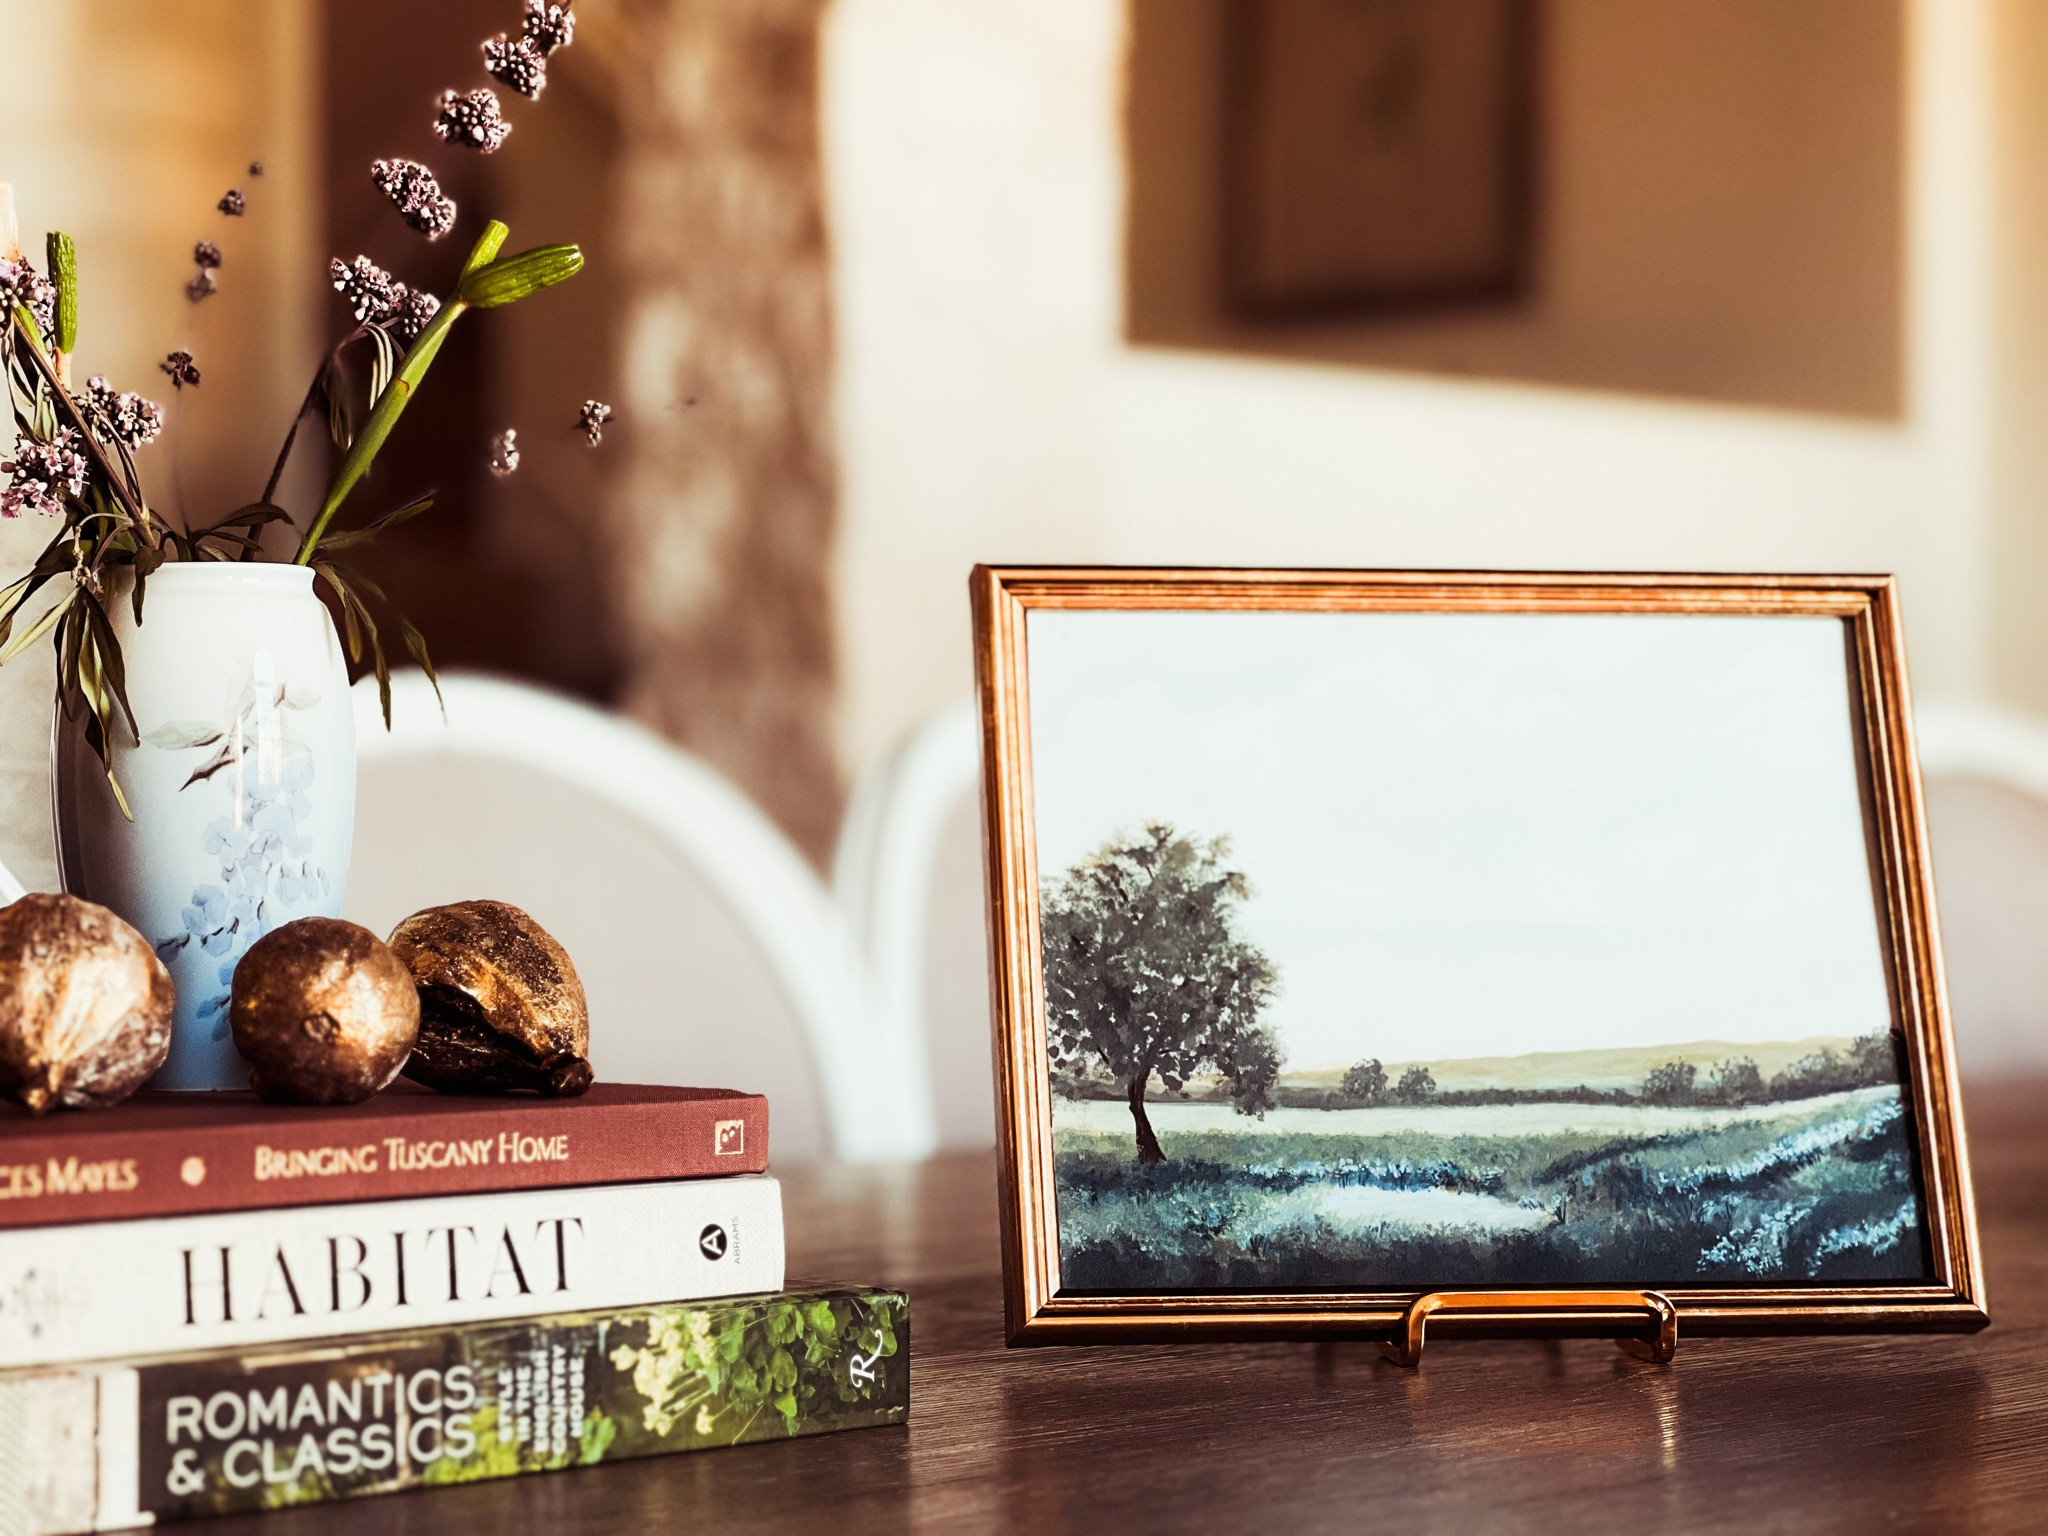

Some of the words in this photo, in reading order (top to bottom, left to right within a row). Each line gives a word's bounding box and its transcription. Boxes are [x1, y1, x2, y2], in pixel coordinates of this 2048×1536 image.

[255, 1145, 378, 1180] BRINGING
[383, 1137, 493, 1171] TUSCANY
[498, 1132, 569, 1163] HOME
[181, 1217, 584, 1325] HABITAT
[731, 1215, 741, 1265] ABRAMS
[166, 1365, 476, 1445] ROMANTICS
[551, 1344, 567, 1456] COUNTRY
[569, 1357, 585, 1438] HOUSE
[166, 1448, 205, 1496] &
[222, 1413, 476, 1488] CLASSICS
